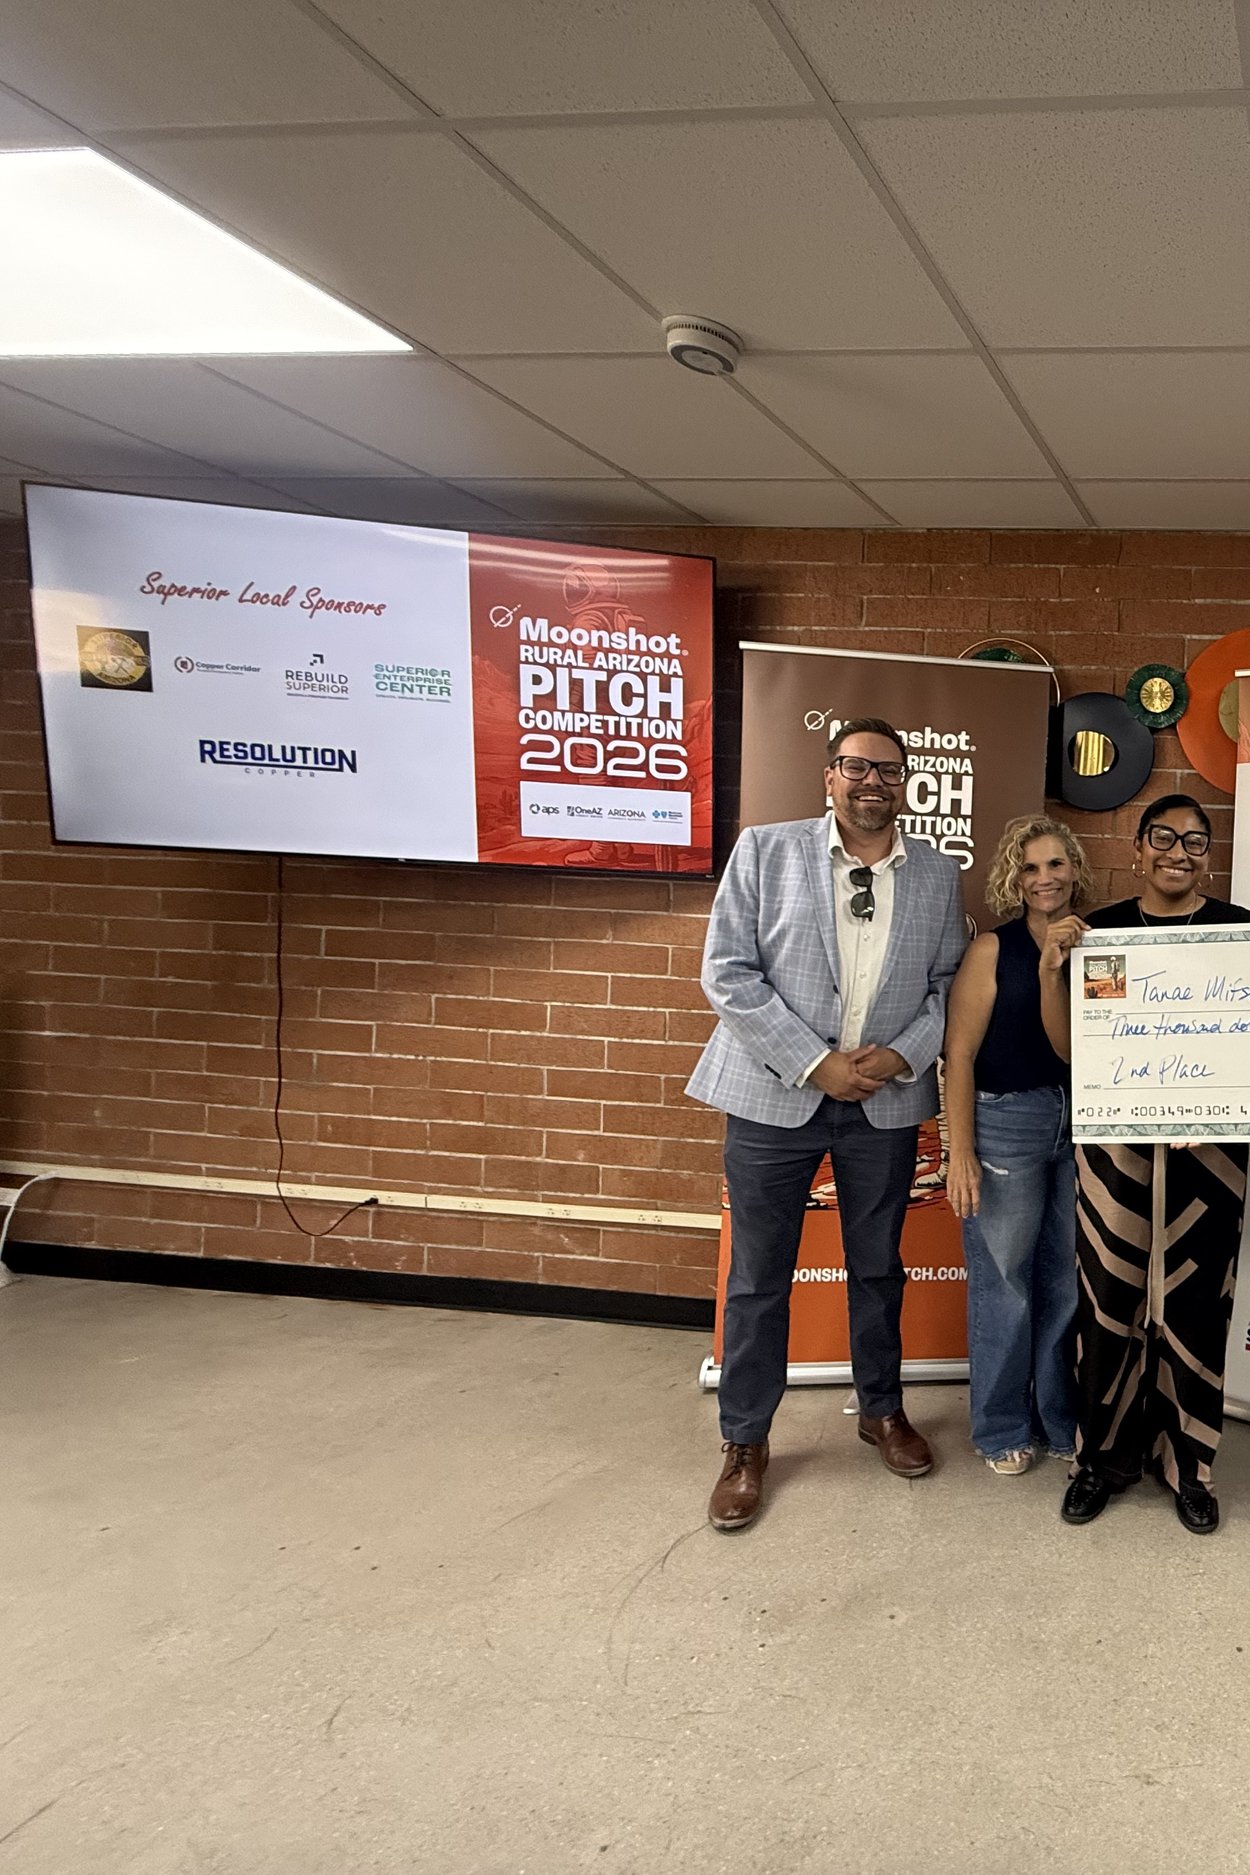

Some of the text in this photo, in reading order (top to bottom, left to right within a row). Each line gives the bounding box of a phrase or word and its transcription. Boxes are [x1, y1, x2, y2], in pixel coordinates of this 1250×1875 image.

[139, 571, 387, 619] Superior Local Sponsors
[519, 644, 683, 676] RURAL ARIZONA
[285, 669, 349, 685] REBUILD
[286, 681, 349, 695] SUPERIOR
[374, 673, 452, 686] ENTERPRISE
[375, 681, 452, 697] CENTER
[519, 663, 684, 720] PITCH
[518, 708, 683, 740] COMPETITION
[199, 739, 357, 773] RESOLUTION
[519, 733, 688, 781] 2026
[244, 767, 316, 778] COPPER
[541, 805, 560, 816] aps
[607, 808, 647, 819] ARIZONA
[1110, 1054, 1216, 1086] 2nd Place
